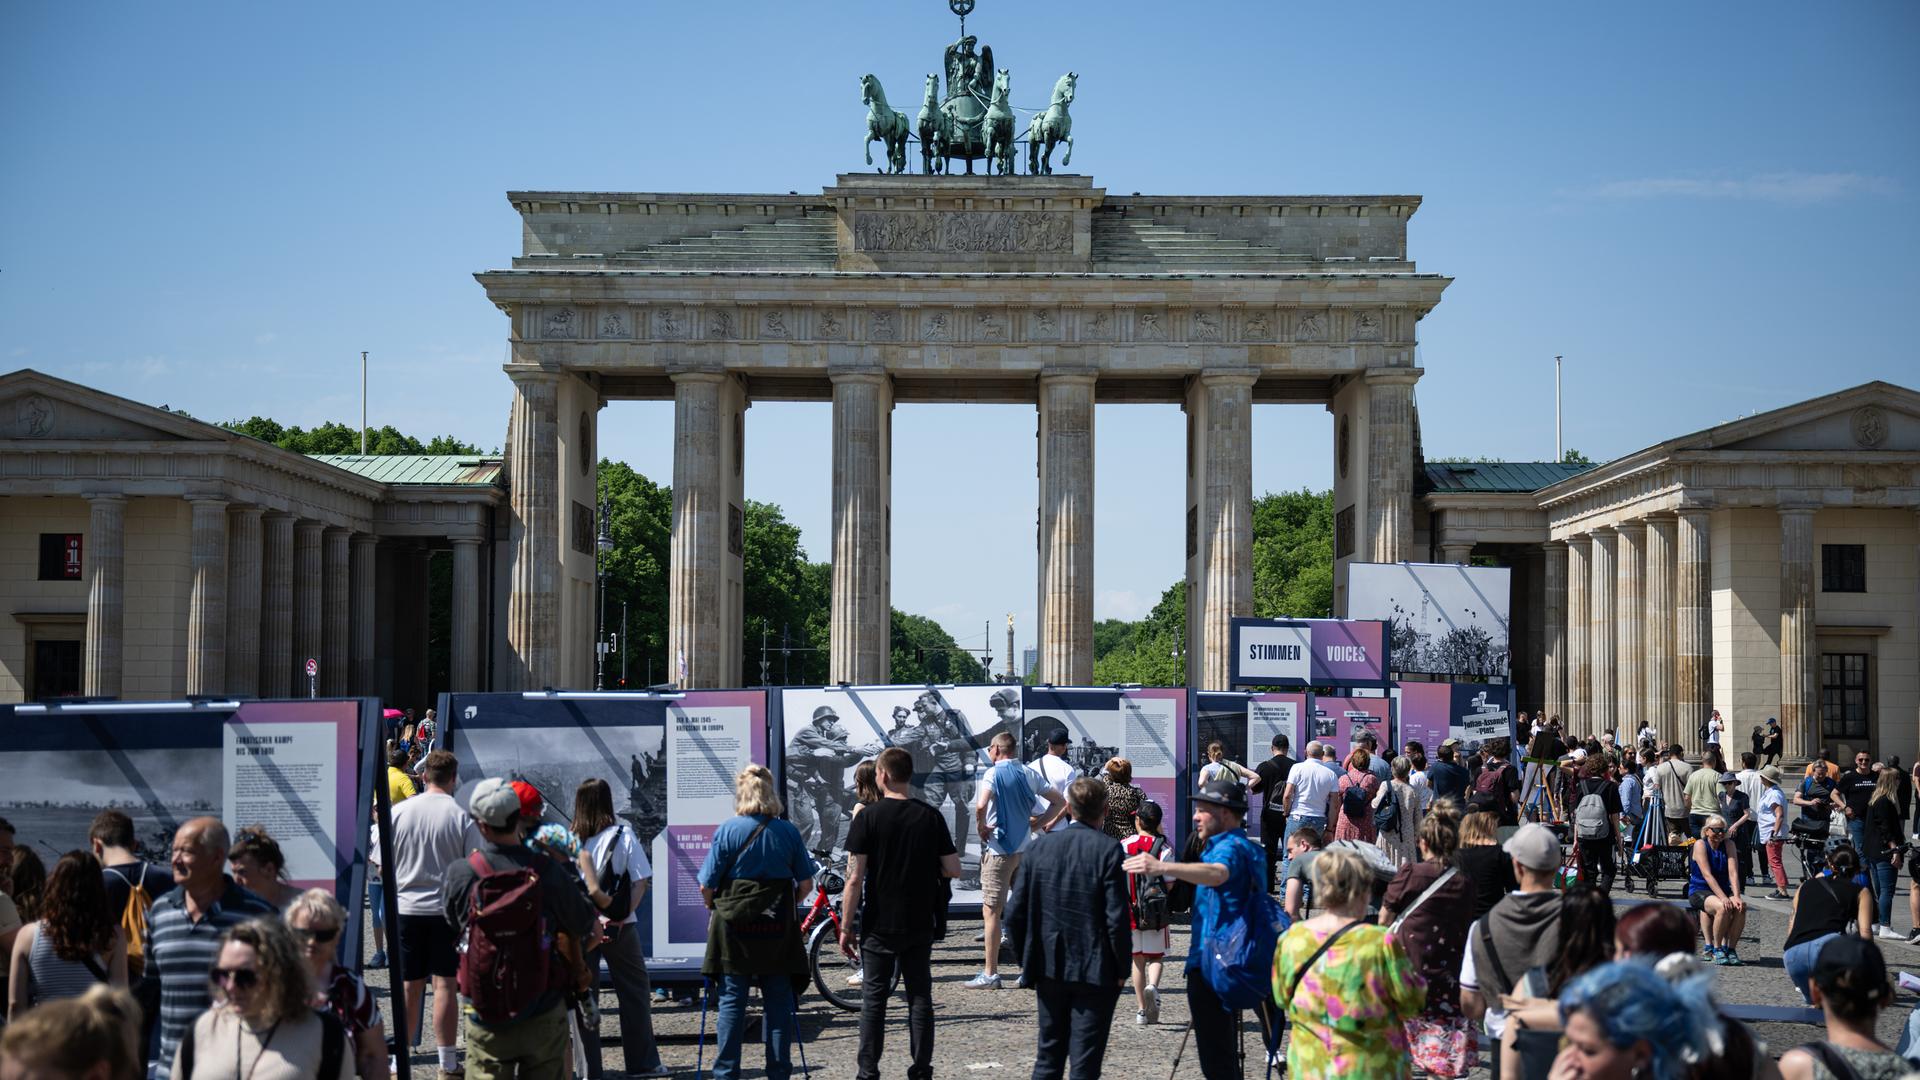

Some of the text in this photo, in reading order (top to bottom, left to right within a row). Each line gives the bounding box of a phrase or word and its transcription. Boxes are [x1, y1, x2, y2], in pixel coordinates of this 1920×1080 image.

[1250, 644, 1301, 660] STIMMEN
[1327, 645, 1366, 662] VOICES
[275, 736, 293, 744] KAMPF
